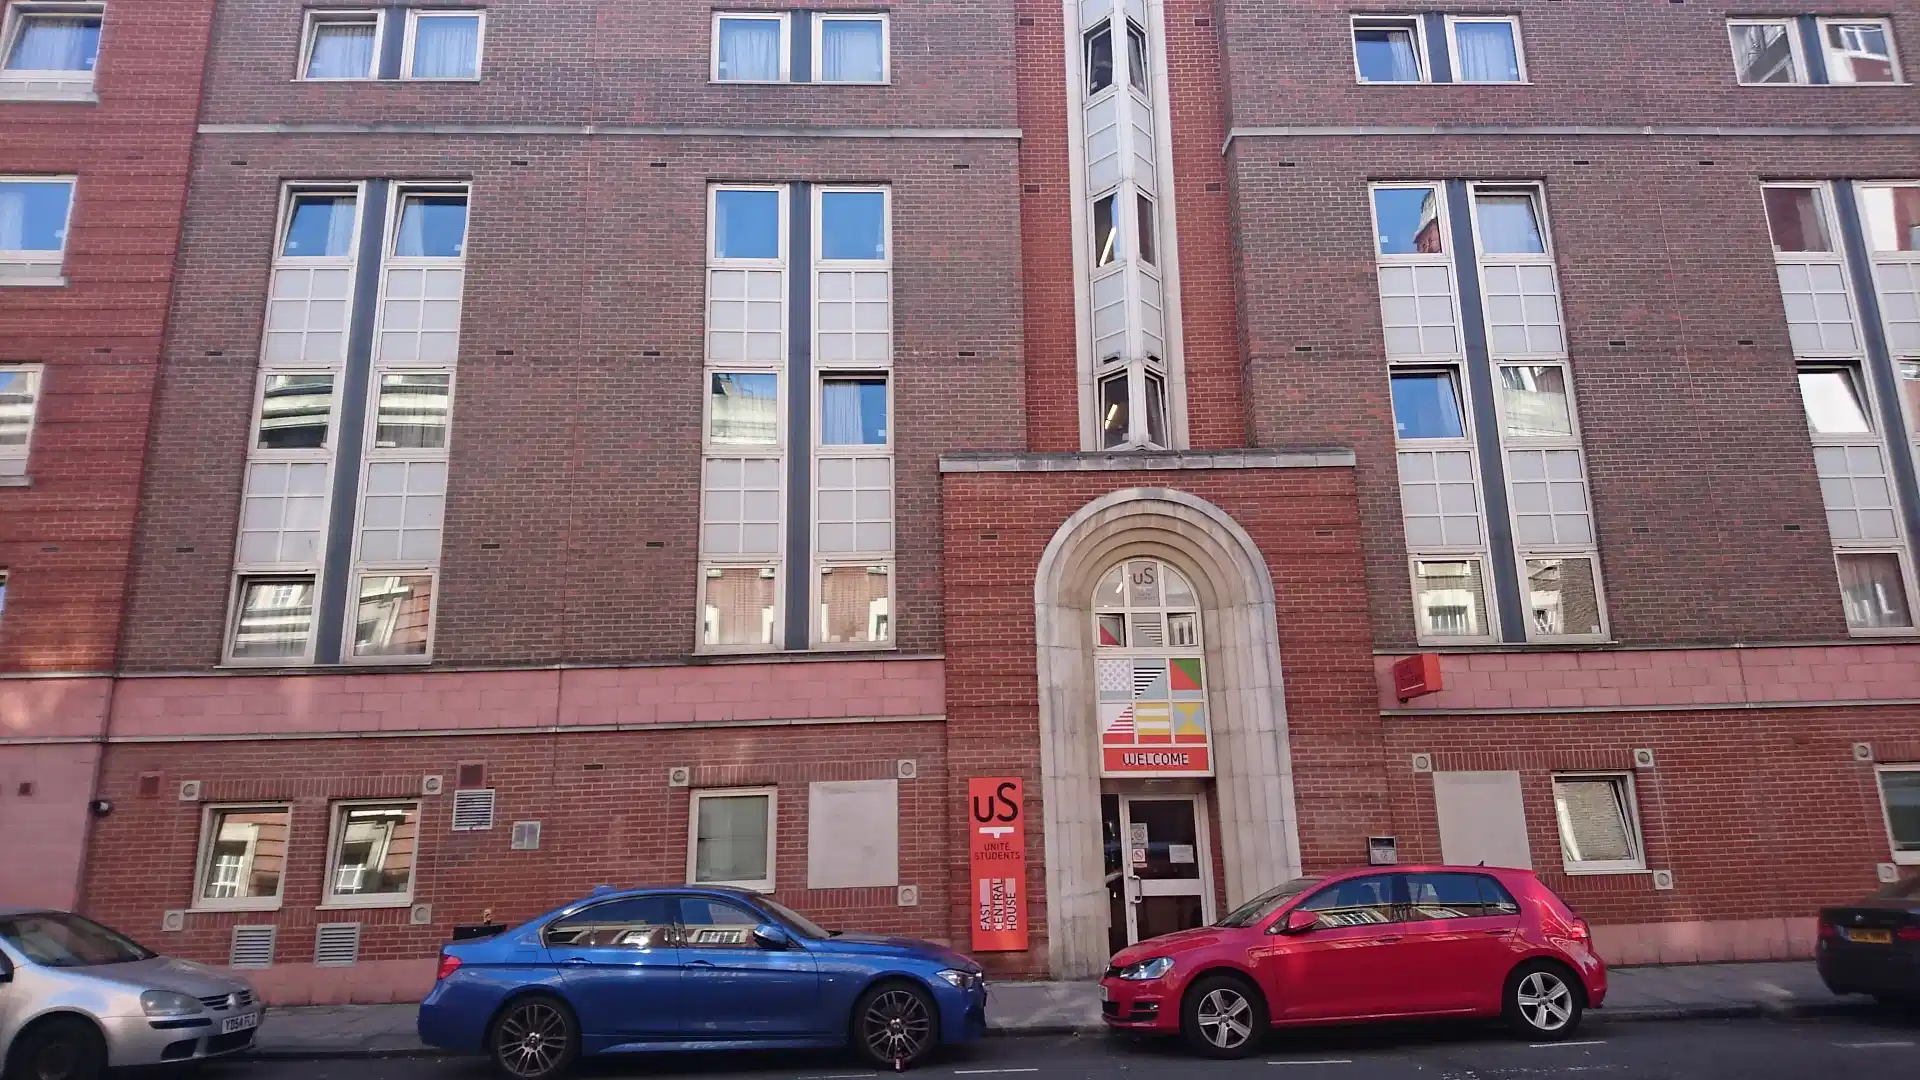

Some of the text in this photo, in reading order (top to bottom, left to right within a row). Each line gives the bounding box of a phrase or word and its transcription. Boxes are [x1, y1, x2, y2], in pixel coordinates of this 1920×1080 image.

[1133, 567, 1154, 585] uS
[1123, 753, 1189, 767] WELCOME
[973, 782, 1018, 822] uS
[975, 851, 1021, 861] STUDENTS
[984, 842, 1011, 851] UNITE
[993, 879, 1004, 932] CENTRAL
[1006, 892, 1017, 931] HOUSE
[981, 903, 991, 932] EAST
